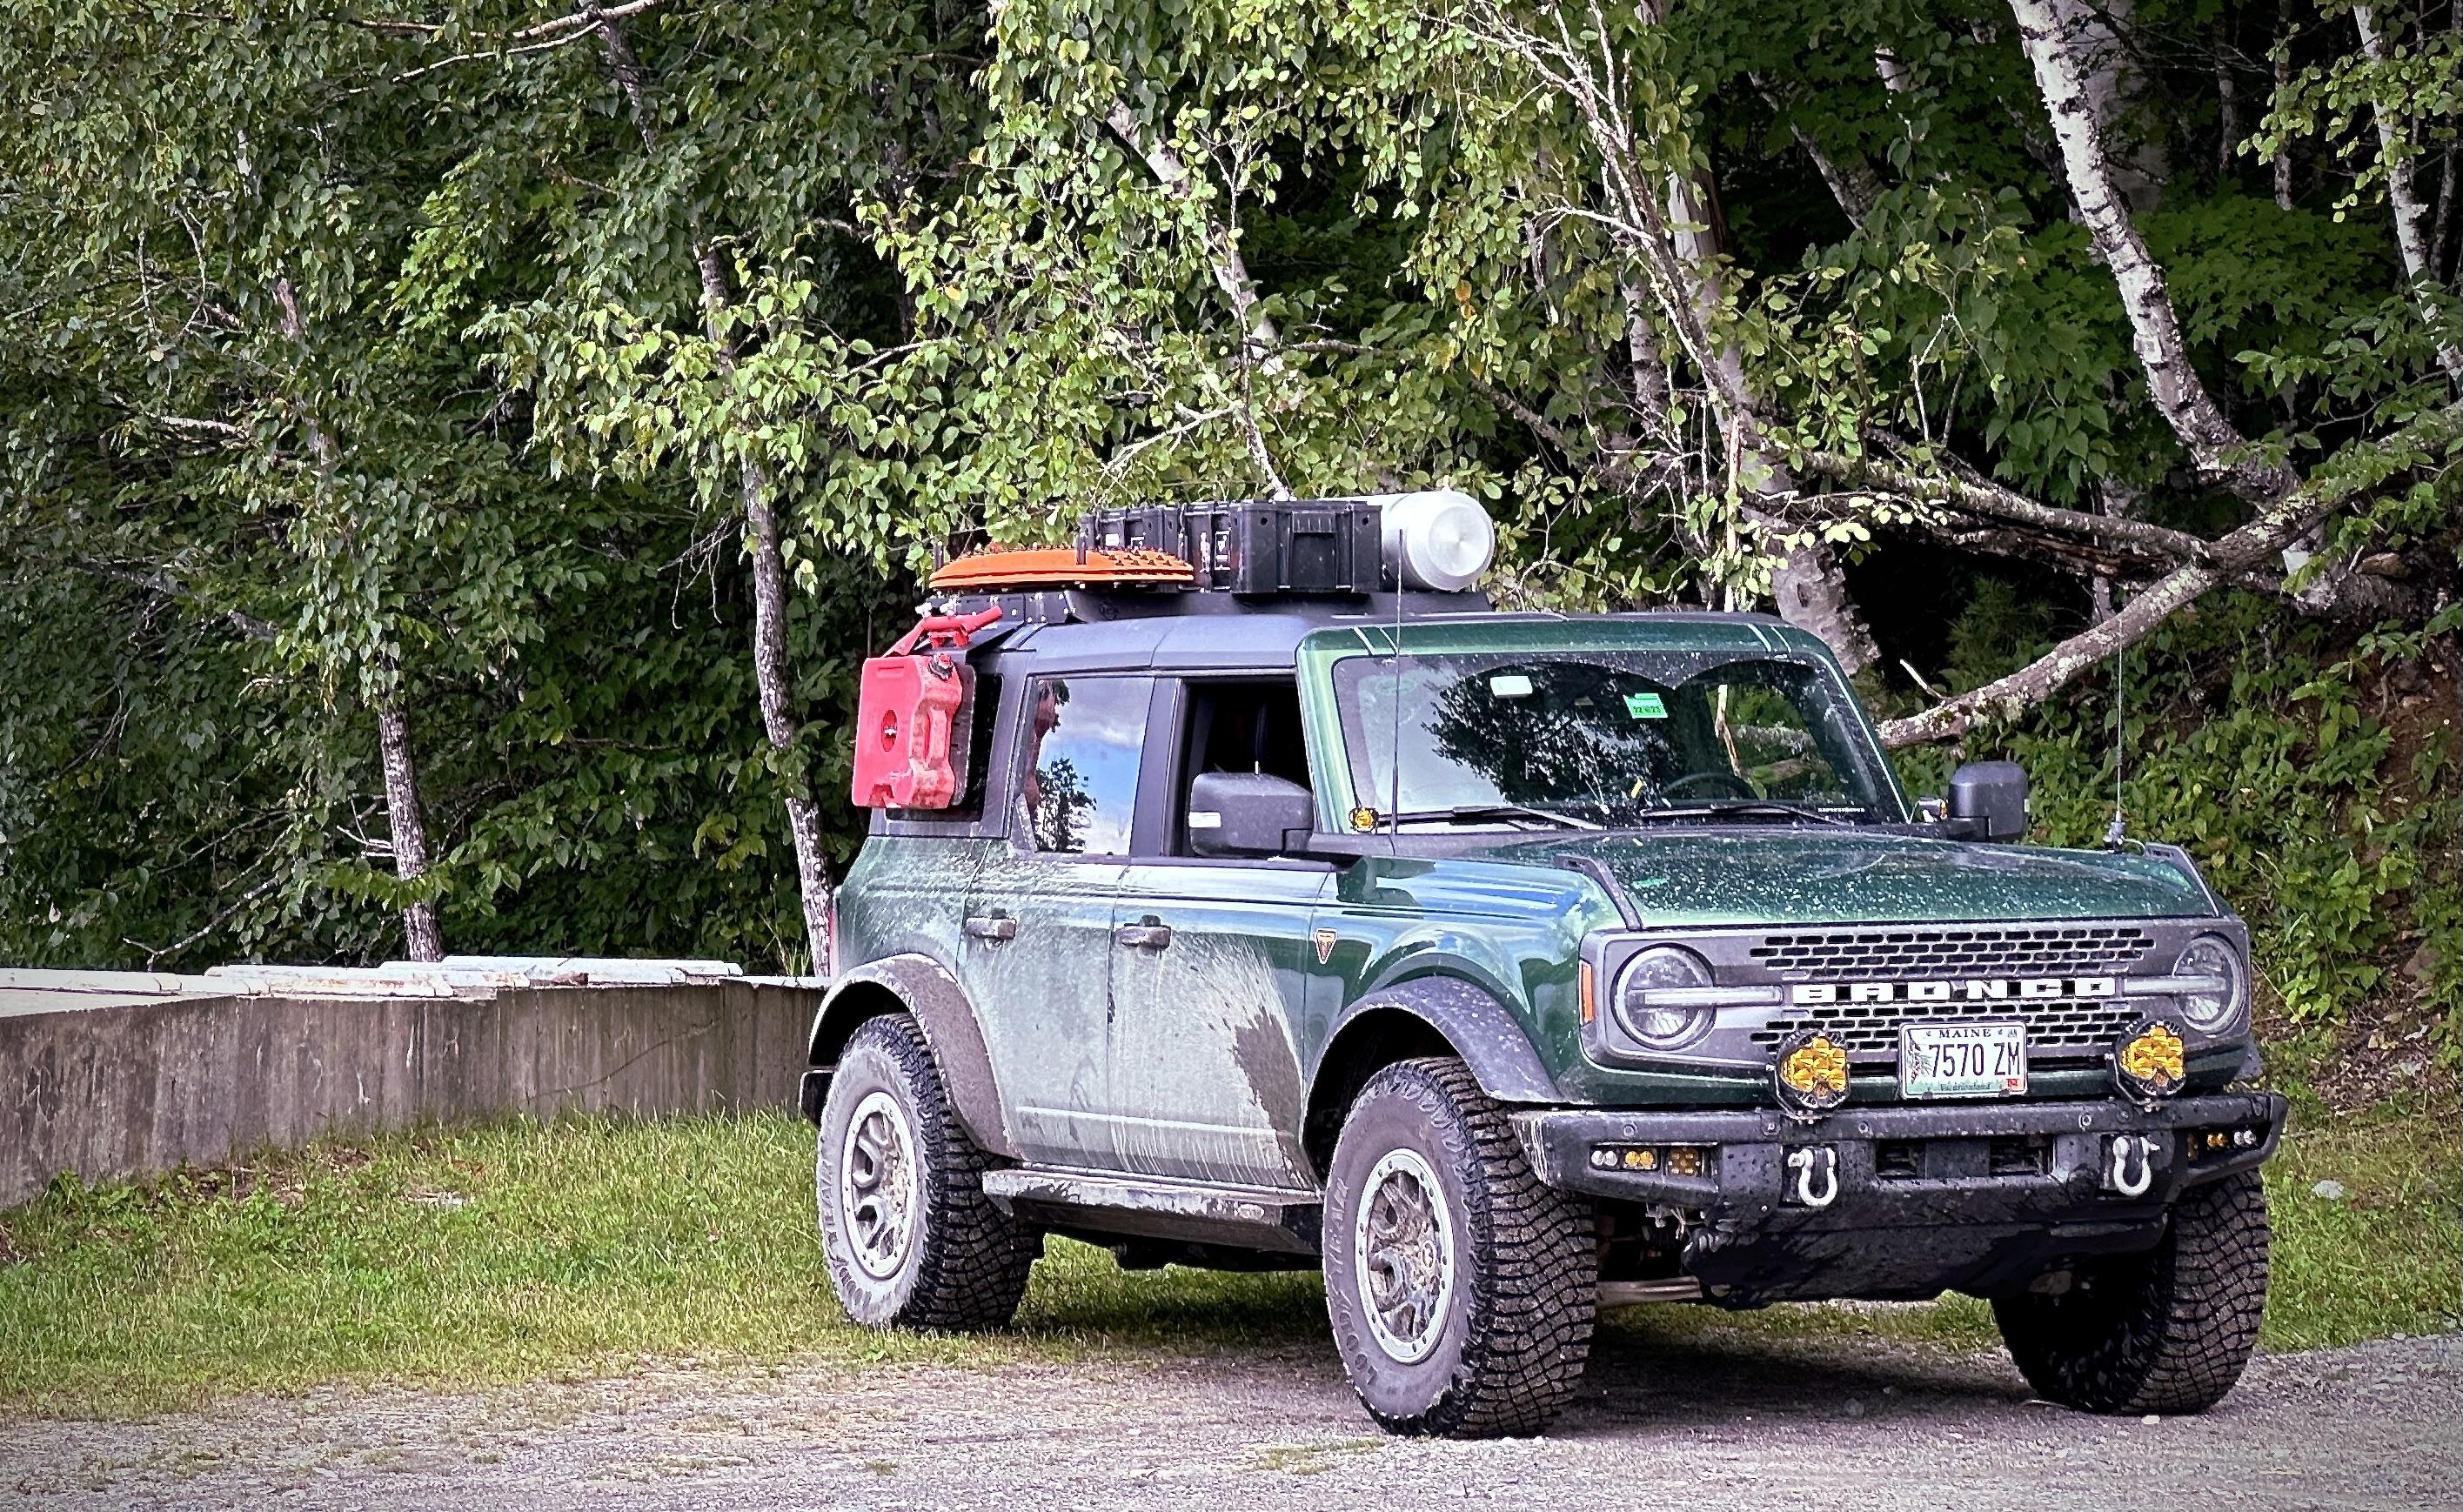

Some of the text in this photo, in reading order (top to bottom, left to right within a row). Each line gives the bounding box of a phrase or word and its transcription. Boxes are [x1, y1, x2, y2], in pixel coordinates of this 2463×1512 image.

[1792, 977, 2117, 1004] BRONCO
[1938, 1028, 1992, 1039] MAINE
[1928, 1041, 2020, 1078] 7570 ZM
